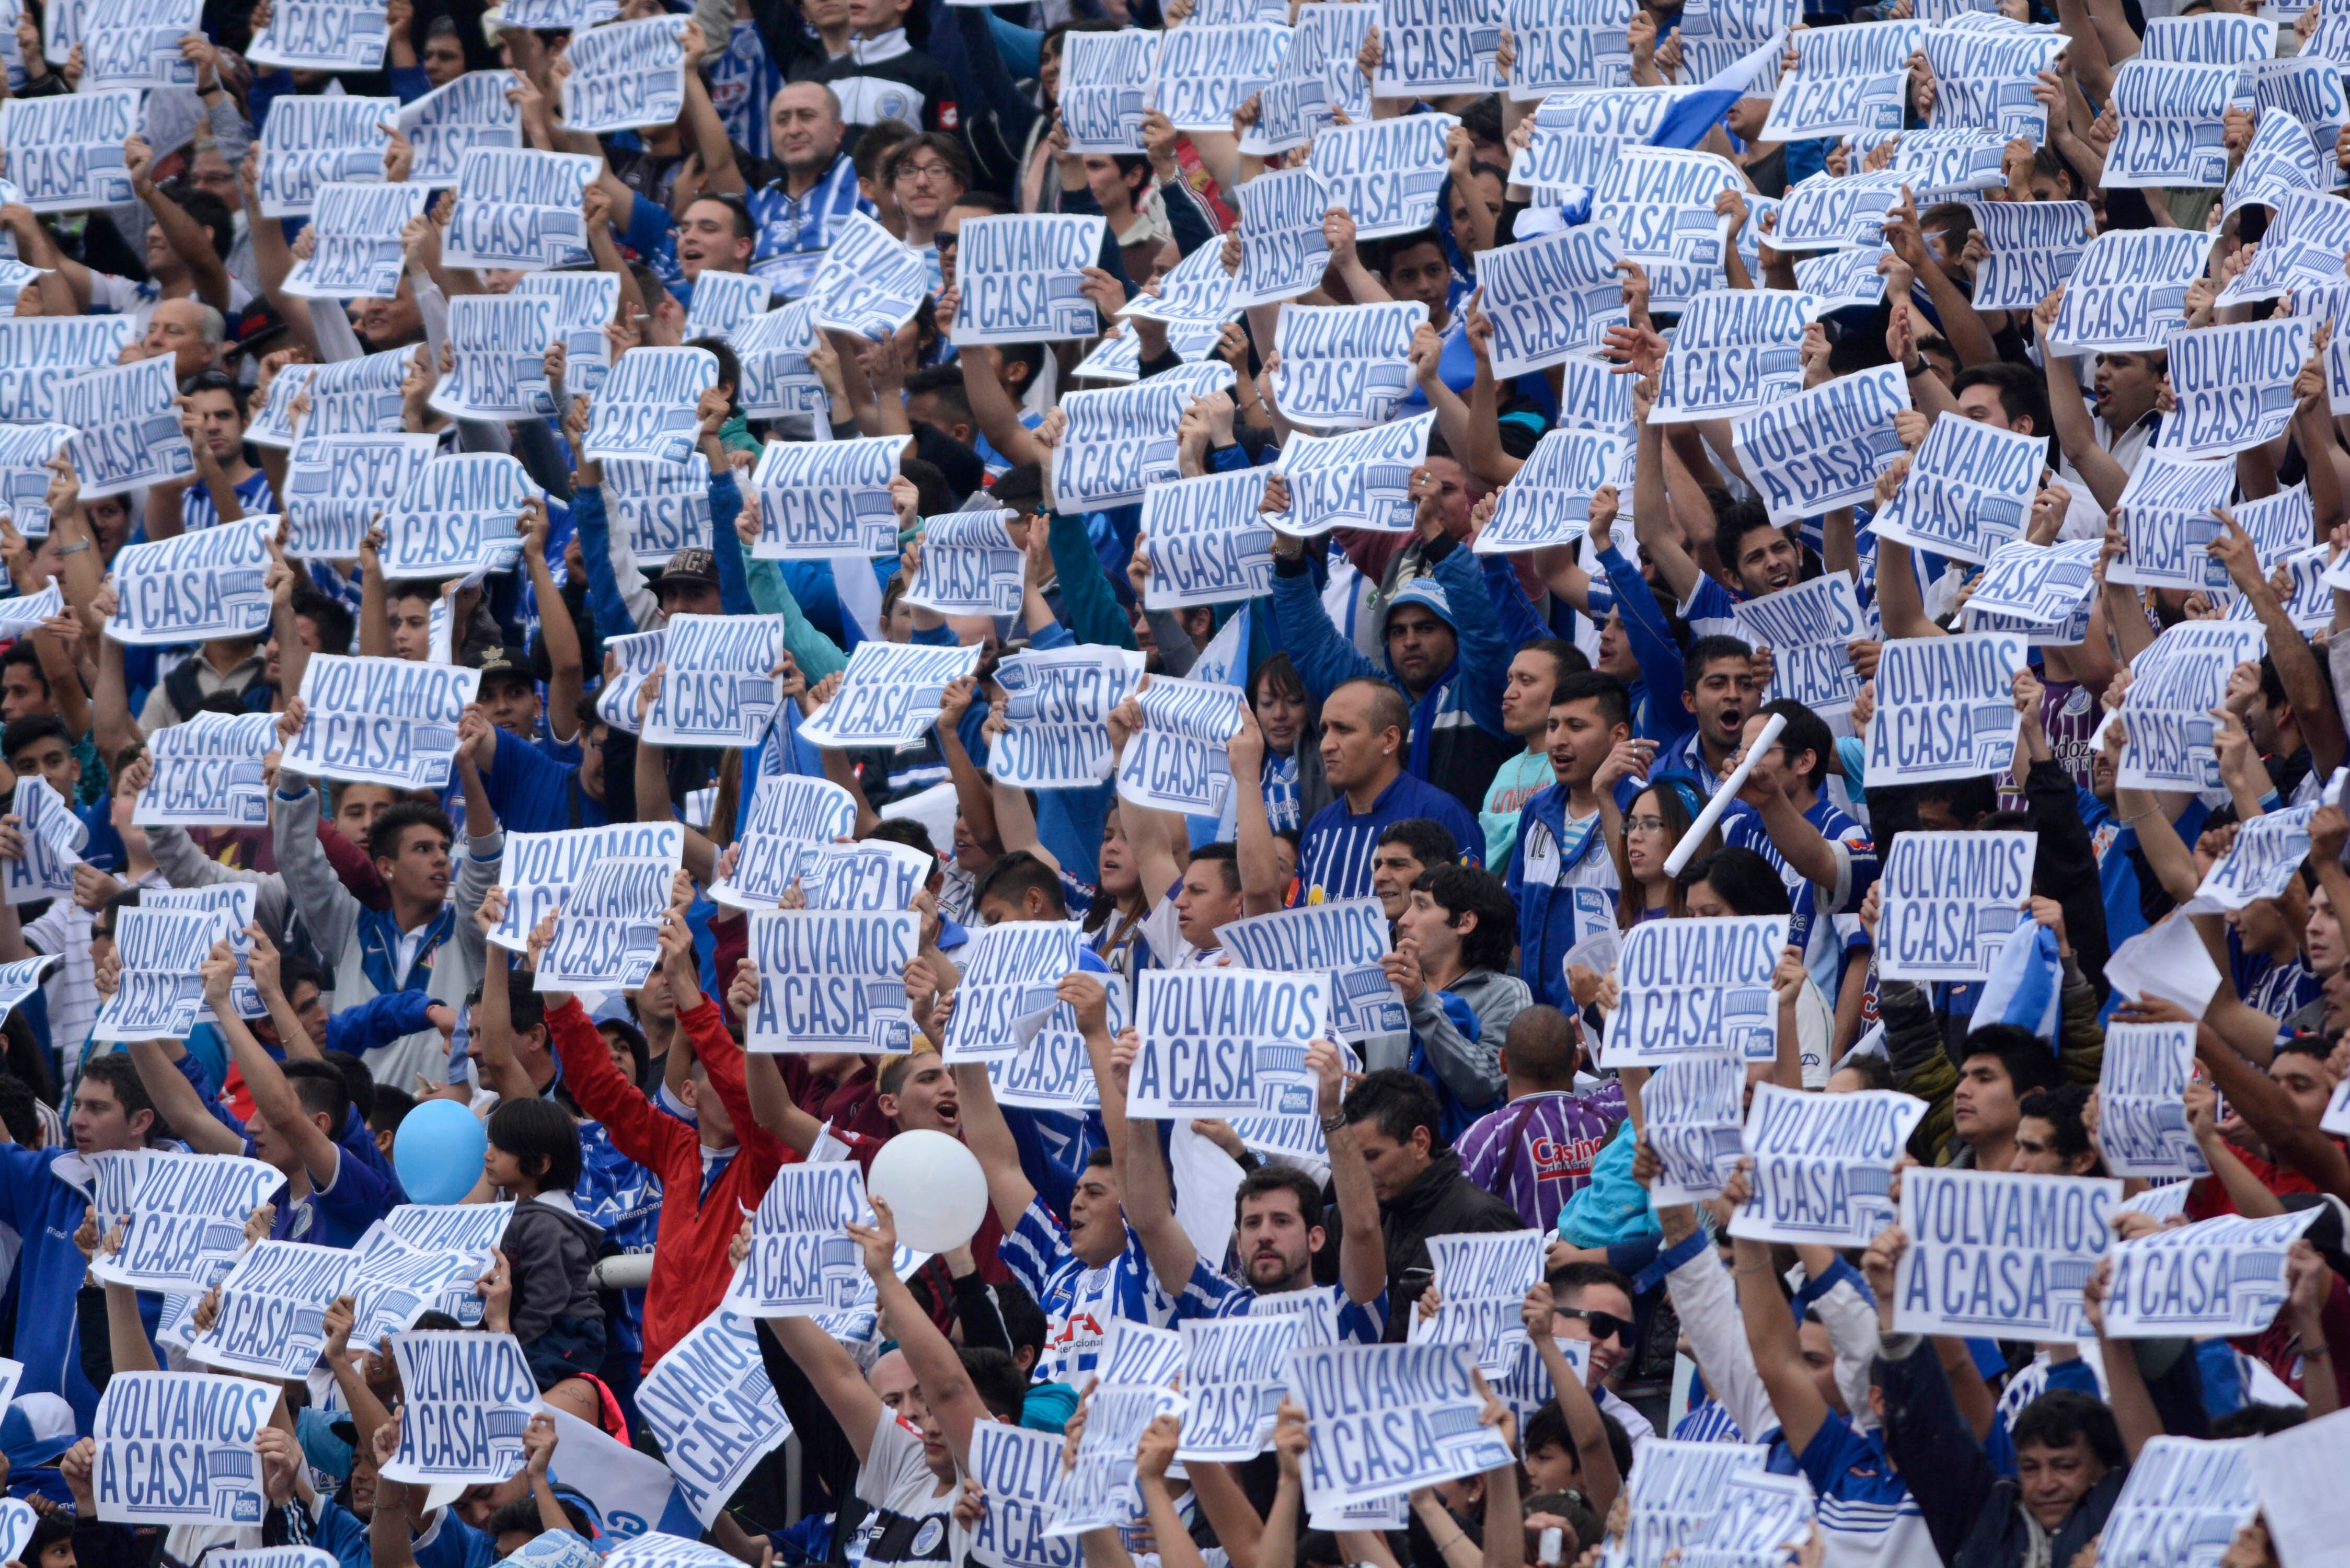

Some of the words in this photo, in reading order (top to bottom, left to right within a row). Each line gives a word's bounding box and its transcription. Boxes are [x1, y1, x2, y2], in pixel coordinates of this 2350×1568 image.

[1071, 34, 1154, 85] VOLVAMOS
[1161, 29, 1288, 77] VOLVAMOS
[1380, 30, 1398, 80] A
[1404, 29, 1473, 80] CASA
[1513, 34, 1524, 85] A
[1527, 31, 1594, 82] CASA
[1797, 25, 1917, 81] VOLVAMOS
[1926, 34, 2058, 81] VOLVAMOS
[1063, 90, 1074, 138] A
[1076, 88, 1121, 143] CASA
[1154, 80, 1167, 125] A
[1168, 78, 1242, 127] CASA
[1775, 85, 1788, 125] A
[1797, 78, 1857, 124] CASA
[1948, 81, 1999, 129] CASA
[2118, 65, 2234, 117] VOLVAMOS
[1314, 118, 1446, 180] VOLVAMOS
[2115, 123, 2128, 172] A
[2133, 120, 2194, 172] CASA
[461, 152, 592, 206] VOLVAMOS
[1240, 175, 1328, 238] VOLVAMOS
[317, 188, 420, 237] VOLVAMOS
[448, 209, 467, 251] A
[474, 209, 544, 257] CASA
[1983, 202, 2087, 251] VOLVAMOS
[318, 238, 376, 283] CASA
[964, 221, 1096, 275] VOLVAMOS
[1237, 243, 1251, 292] A
[1254, 231, 1303, 290] CASA
[1480, 226, 1618, 309] VOLVAMOS
[1979, 257, 1997, 305] A
[2001, 250, 2057, 305] CASA
[2071, 233, 2207, 286] VOLVAMOS
[451, 301, 549, 351] VOLVAMOS
[957, 275, 973, 328] A
[981, 274, 1047, 328] CASA
[1494, 316, 1516, 362] A
[1520, 292, 1588, 356] CASA
[2052, 290, 2073, 341] A
[2078, 286, 2146, 339] CASA
[1282, 308, 1420, 359] VOLVAMOS
[2170, 325, 2301, 395] VOLVAMOS
[61, 368, 172, 430] VOLVAMOS
[445, 354, 462, 401] A
[473, 354, 519, 405] CASA
[1296, 359, 1367, 412] CASA
[1659, 356, 1675, 408] A
[1684, 350, 1759, 407] CASA
[598, 405, 665, 447] CASA
[1065, 383, 1182, 442] VOLVAMOS
[1741, 370, 1904, 467] VOLVAMOS
[2167, 397, 2185, 447] A
[2193, 387, 2258, 444] CASA
[84, 420, 154, 479] CASA
[762, 440, 896, 487] VOLVAMOS
[1058, 453, 1073, 498] A
[1081, 439, 1145, 496] CASA
[1287, 418, 1419, 478] VOLVAMOS
[1761, 470, 1793, 510] A
[1791, 437, 1875, 501] CASA
[762, 493, 779, 543] A
[786, 489, 858, 543] CASA
[1302, 462, 1365, 521] CASA
[1491, 491, 1507, 539] A
[1503, 489, 1566, 540] CASA
[1885, 475, 1908, 521] A
[1909, 474, 1979, 545] CASA
[121, 519, 270, 576] VOLVAMOS
[399, 515, 481, 563] CASA
[1153, 540, 1169, 592] A
[1174, 531, 1247, 589] CASA
[114, 581, 131, 627] A
[142, 572, 222, 627] CASA
[917, 547, 931, 598] A
[936, 550, 989, 599] CASA
[1739, 579, 1854, 650] VOLVAMOS
[666, 619, 779, 671] VOLVAMOS
[843, 644, 978, 684] VOLVAMOS
[1787, 642, 1847, 702] CASA
[1876, 640, 2017, 705] VOLVAMOS
[312, 656, 474, 723] VOLVAMOS
[652, 676, 666, 725] A
[675, 674, 740, 728] CASA
[815, 690, 836, 729] A
[839, 685, 912, 729] CASA
[292, 711, 315, 760] A
[324, 714, 411, 771] CASA
[1872, 709, 1889, 768] A
[1898, 703, 1971, 765] CASA
[142, 762, 162, 808] A
[165, 758, 229, 808] CASA
[1122, 739, 1147, 782] A
[1152, 743, 1208, 795] CASA
[561, 863, 669, 917] VOLVAMOS
[745, 842, 803, 893] CASA
[1884, 839, 2021, 898] VOLVAMOS
[542, 927, 560, 973] A
[561, 920, 627, 974] CASA
[756, 917, 911, 976] VOLVAMOS
[1228, 905, 1381, 969] VOLVAMOS
[1622, 923, 1778, 987] VOLVAMOS
[1878, 904, 1891, 961] A
[1898, 902, 1976, 961] CASA
[105, 978, 121, 1024] A
[123, 973, 181, 1025] CASA
[756, 977, 778, 1035] A
[787, 977, 869, 1035] CASA
[1147, 977, 1318, 1039] VOLVAMOS
[1611, 991, 1631, 1048] A
[1640, 986, 1722, 1047] CASA
[1137, 1039, 1160, 1100] A
[1169, 1039, 1255, 1101] CASA
[1755, 1094, 1909, 1160] VOLVAMOS
[134, 1158, 273, 1219] VOLVAMOS
[1746, 1160, 1764, 1218] A
[1777, 1158, 1849, 1223] CASA
[1915, 1178, 2107, 1253] VOLVAMOS
[132, 1212, 205, 1273] CASA
[738, 1242, 757, 1298] A
[763, 1237, 822, 1299] CASA
[232, 1244, 360, 1309] VOLVAMOS
[1907, 1248, 1929, 1312] A
[1942, 1248, 2049, 1320] CASA
[2109, 1253, 2129, 1314] A
[2140, 1248, 2230, 1316] CASA
[226, 1293, 295, 1356] CASA
[404, 1341, 534, 1402] VOLVAMOS
[1293, 1343, 1477, 1419] VOLVAMOS
[105, 1376, 266, 1440] VOLVAMOS
[399, 1411, 414, 1463] A
[420, 1404, 490, 1466] CASA
[101, 1443, 120, 1504] A
[127, 1443, 209, 1505] CASA
[1308, 1422, 1332, 1490] A
[1333, 1405, 1444, 1485] CASA
